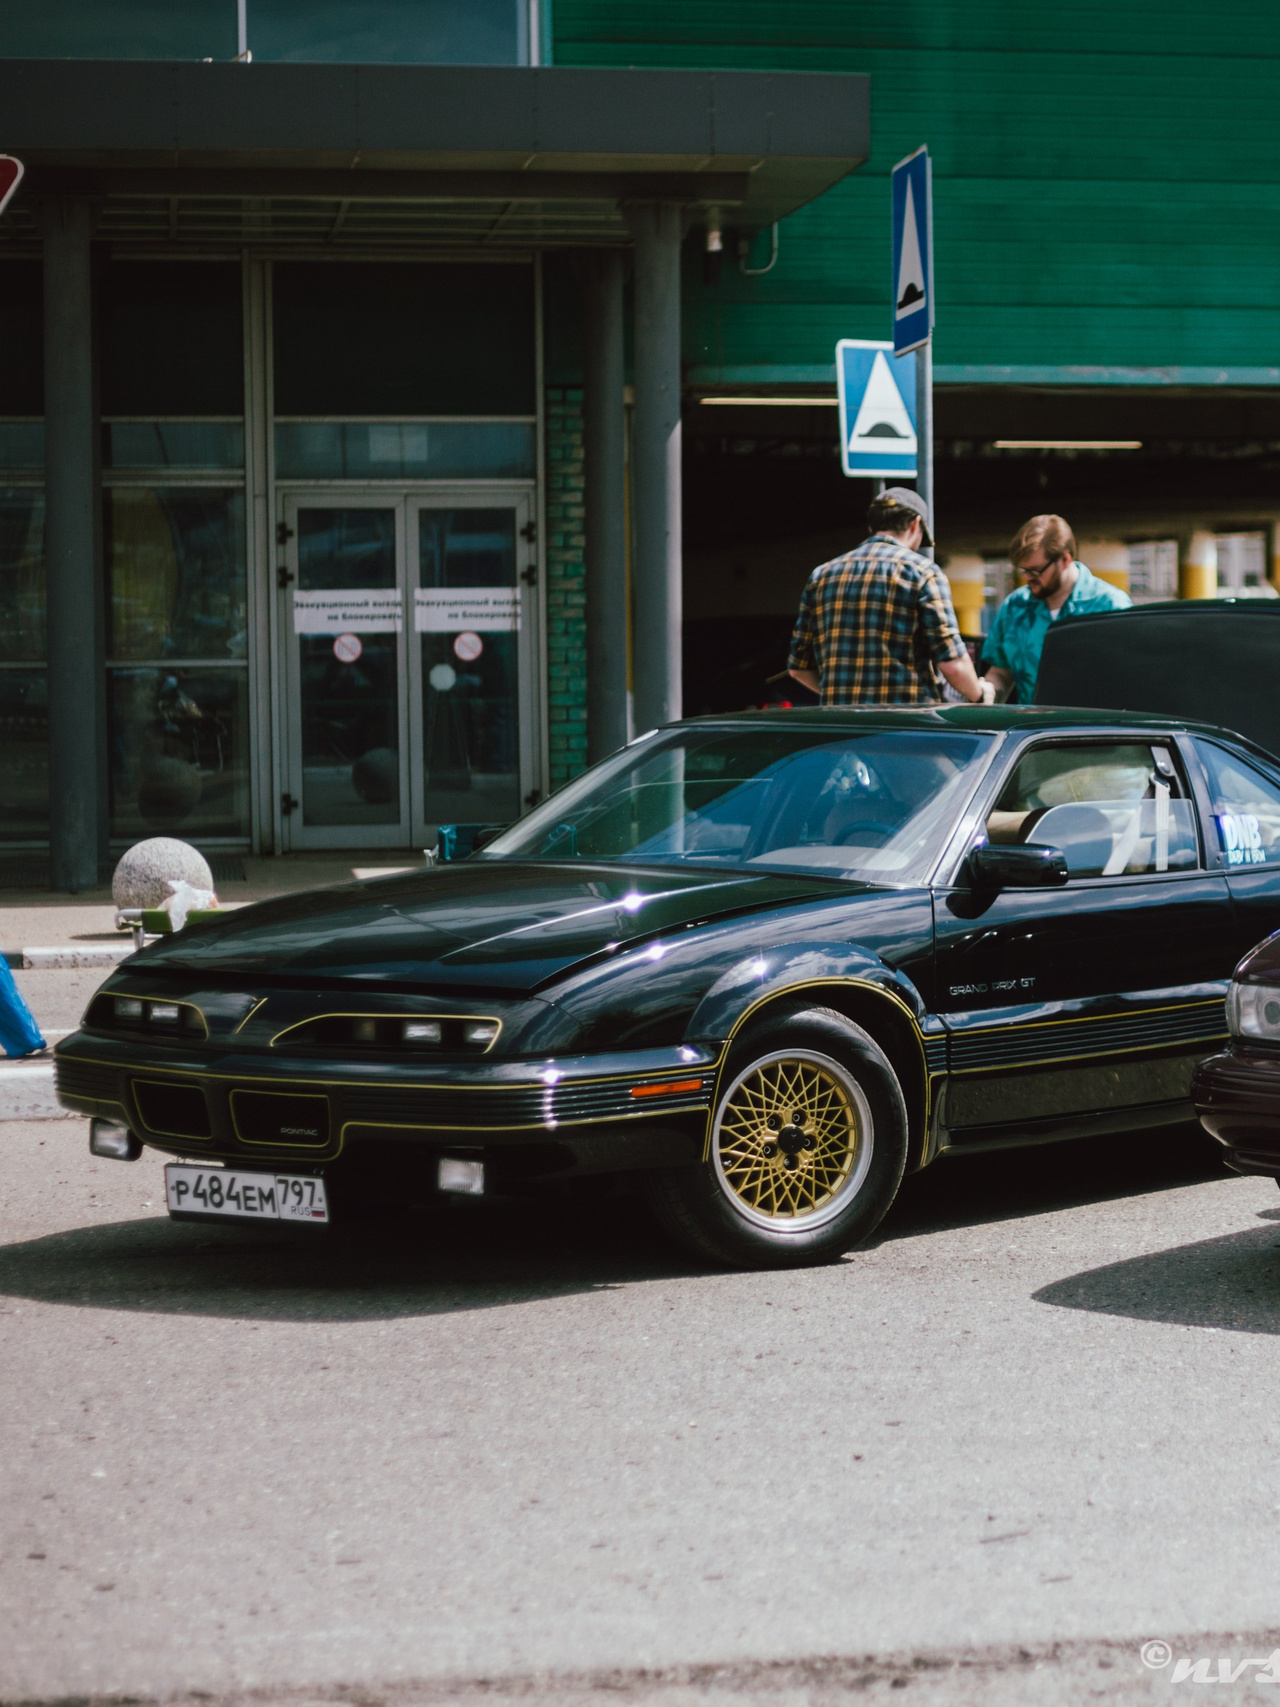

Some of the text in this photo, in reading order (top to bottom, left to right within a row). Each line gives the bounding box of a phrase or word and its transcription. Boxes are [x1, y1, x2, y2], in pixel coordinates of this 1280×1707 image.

[1222, 814, 1262, 849] DNB
[950, 977, 1036, 995] GRAND PRIX GT
[280, 1127, 319, 1136] PONTIAC
[277, 1179, 316, 1206] 797
[290, 1205, 311, 1216] RUS
